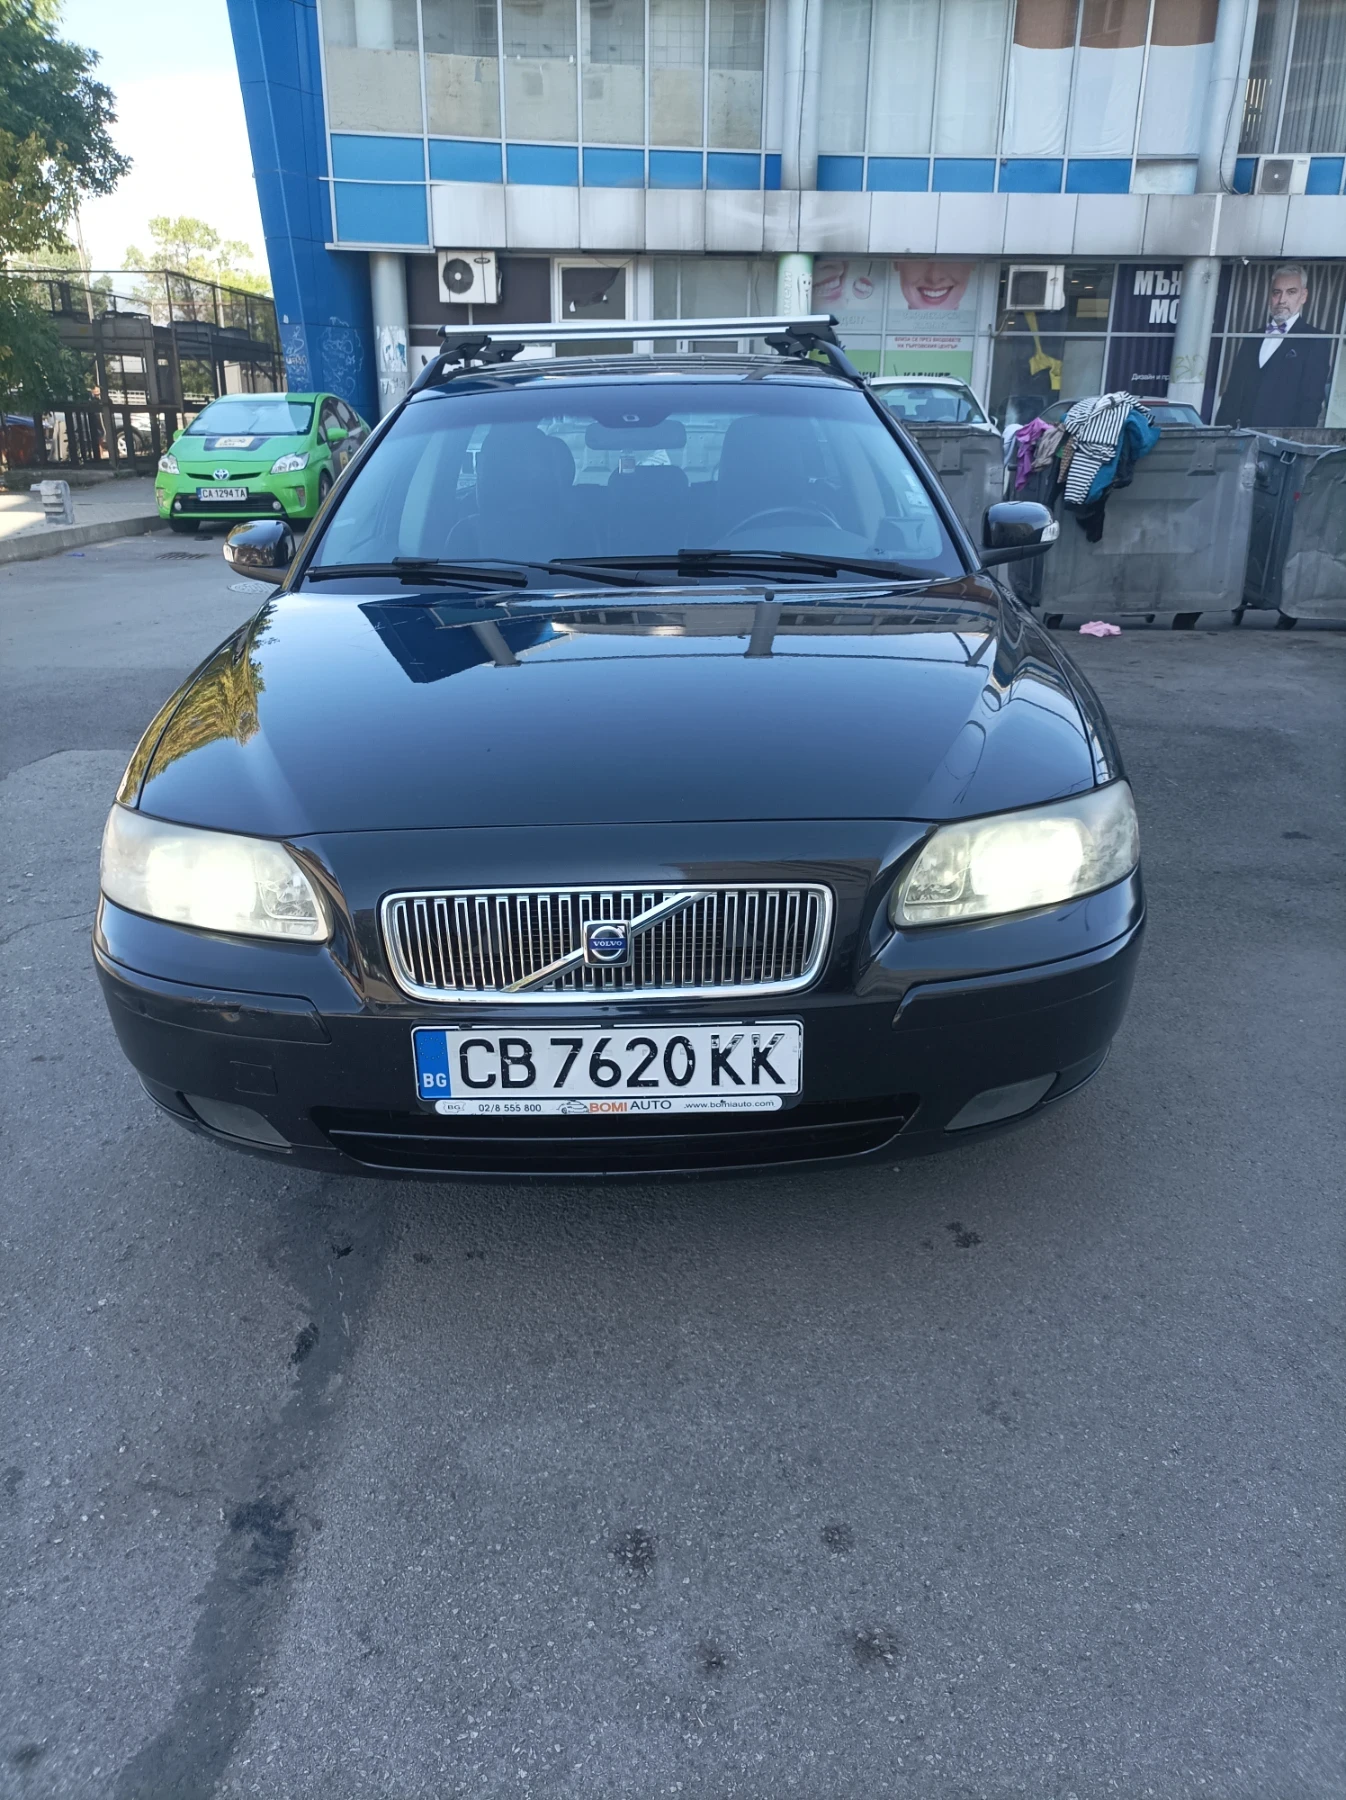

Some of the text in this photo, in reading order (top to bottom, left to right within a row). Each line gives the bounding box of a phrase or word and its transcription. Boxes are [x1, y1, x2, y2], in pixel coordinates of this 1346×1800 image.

[1131, 373, 1155, 381] Дизайн
[202, 489, 246, 498] CA 1294 TA
[458, 1032, 787, 1090] CB 7620 KK
[423, 1073, 447, 1088] BG
[478, 1103, 542, 1113] 02/8 555 800
[589, 1100, 672, 1113] BOMI AUTO
[685, 1100, 775, 1108] www.bomiauto.com
